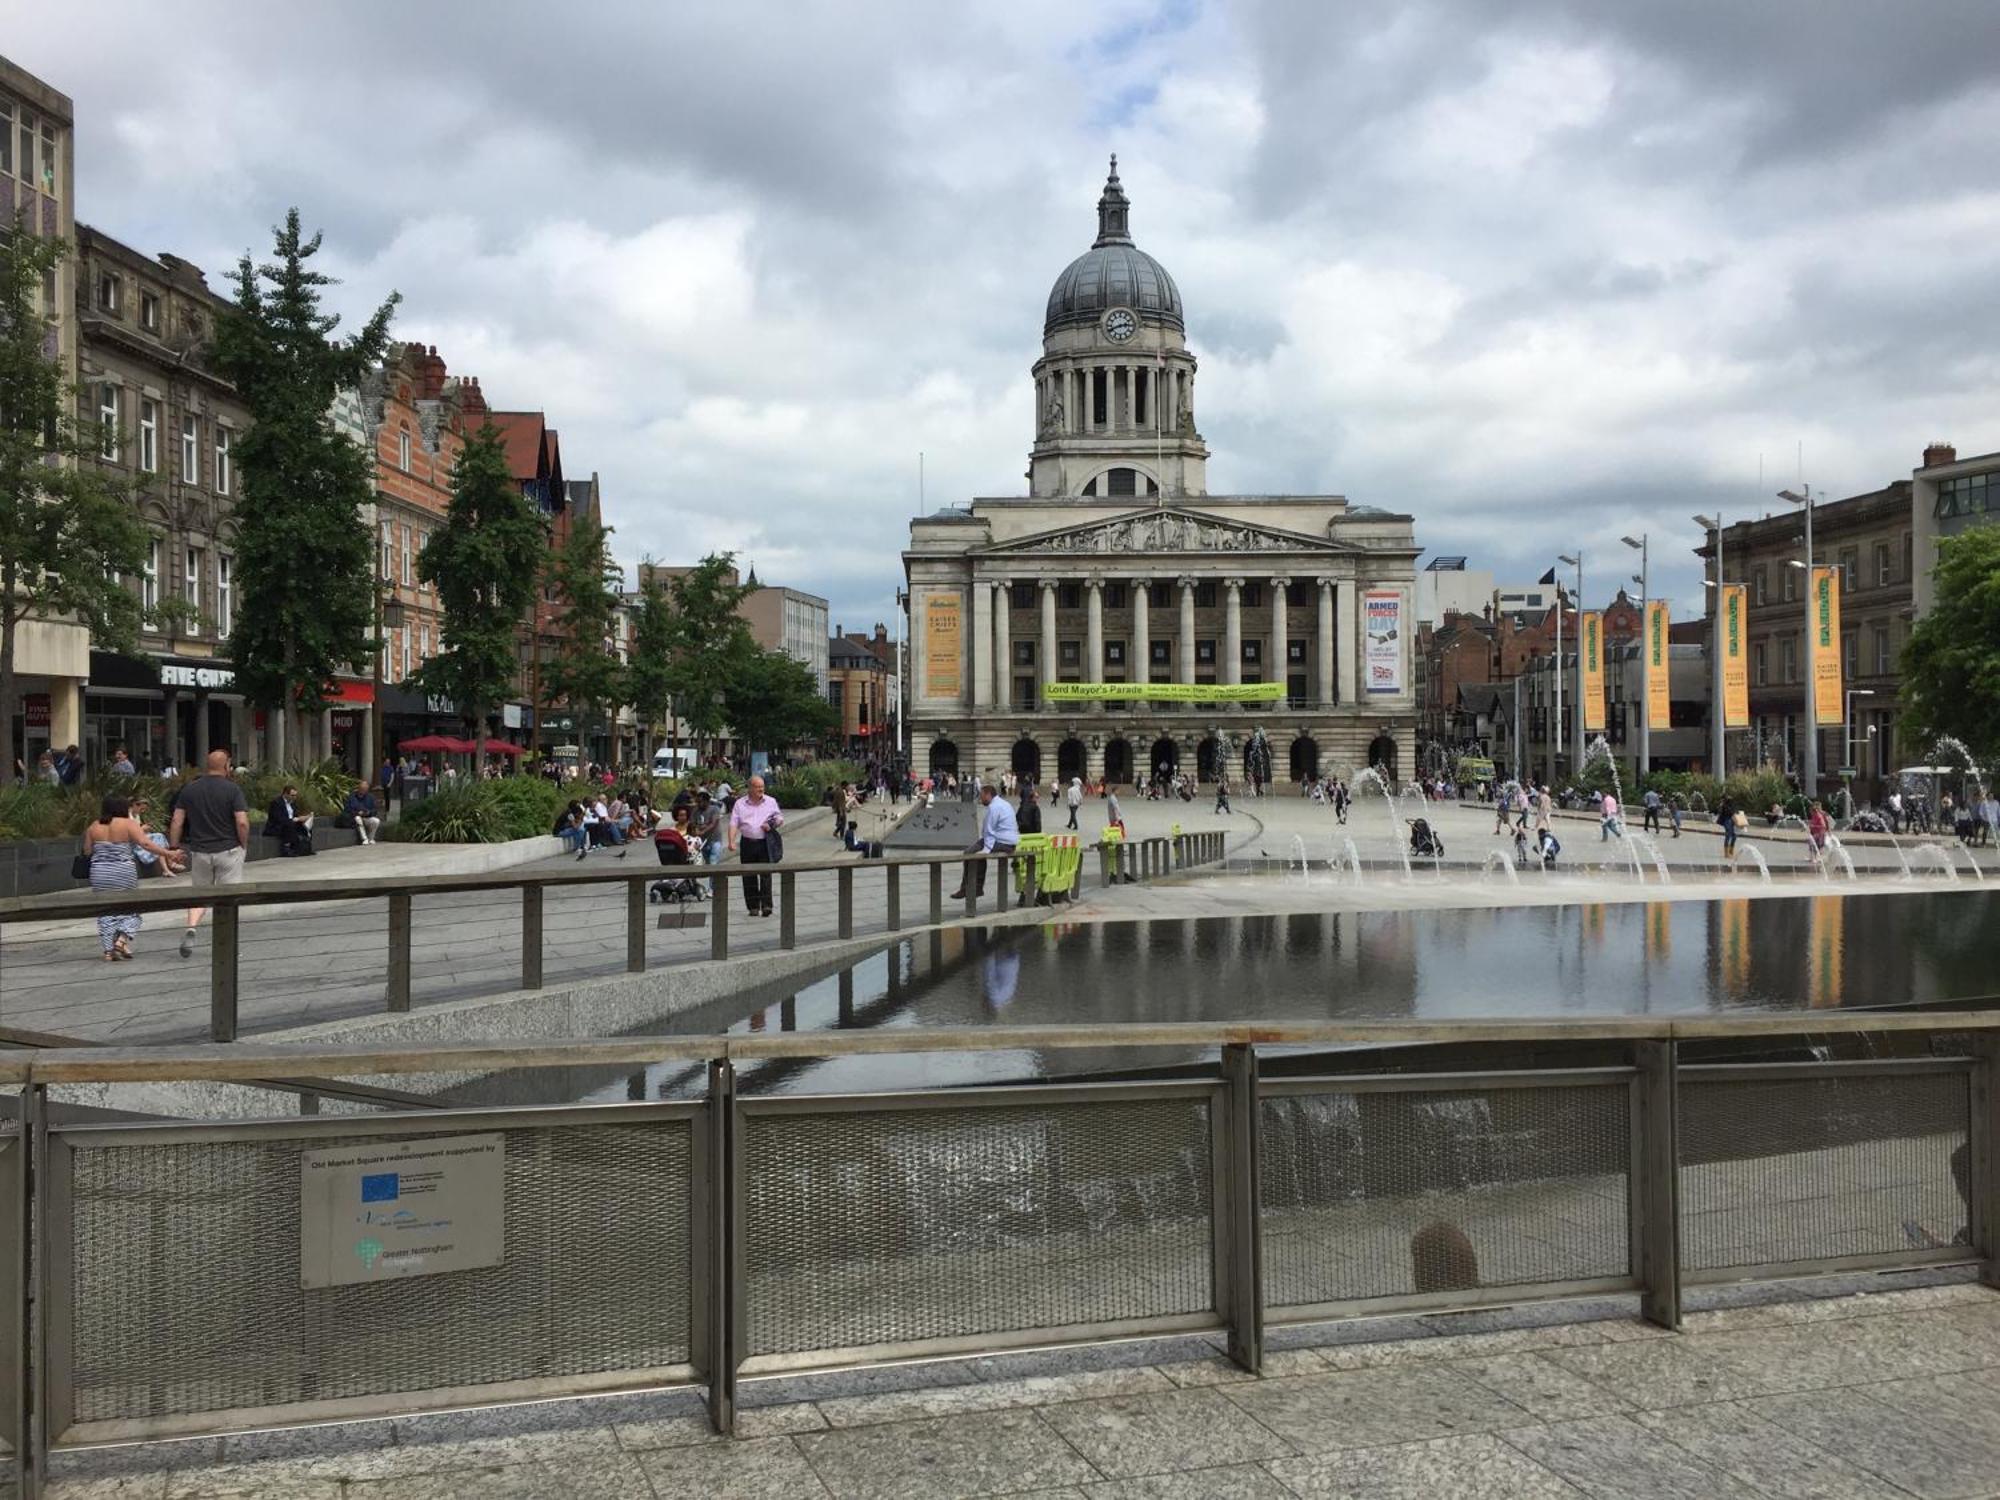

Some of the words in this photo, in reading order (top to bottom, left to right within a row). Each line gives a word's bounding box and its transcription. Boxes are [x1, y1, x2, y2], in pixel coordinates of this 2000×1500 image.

[1368, 617, 1397, 630] DAY
[161, 665, 196, 686] FIVE
[1047, 685, 1069, 694] Lord
[1071, 685, 1108, 695] Mayor's
[1110, 685, 1143, 694] Parade
[334, 717, 353, 728] MOD
[311, 1160, 328, 1169] Old
[328, 1158, 355, 1168] Market
[357, 1155, 385, 1166] Square
[386, 1150, 444, 1162] redevelopment
[446, 1146, 484, 1156] supported
[485, 1144, 496, 1153] by
[411, 1243, 454, 1256] Nottingham
